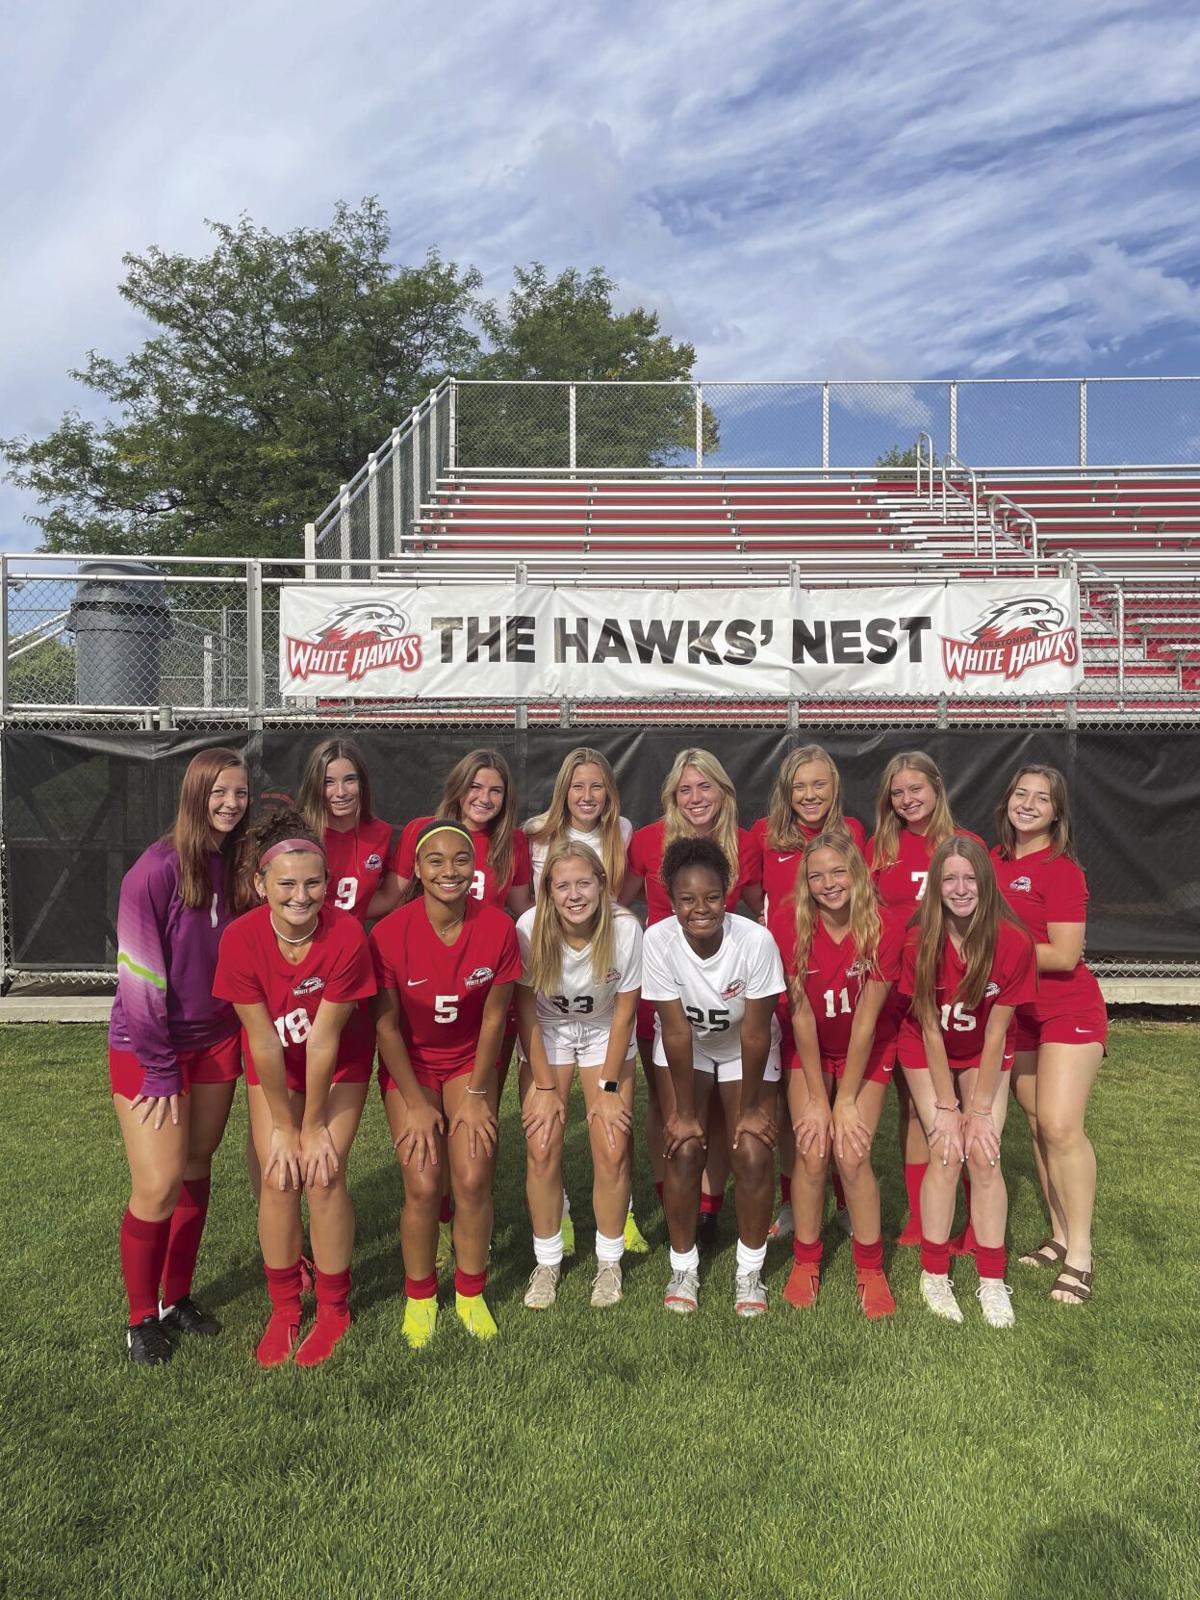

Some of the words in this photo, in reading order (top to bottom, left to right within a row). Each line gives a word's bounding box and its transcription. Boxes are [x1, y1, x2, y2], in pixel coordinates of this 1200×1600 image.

[431, 616, 535, 663] THE
[792, 617, 932, 665] NEST
[945, 640, 1006, 677] WHITE
[1008, 630, 1076, 675] HAWKS
[978, 632, 1036, 648] WESTONKA
[289, 639, 349, 677] WHITE
[350, 637, 419, 677] HAWKS
[335, 876, 359, 910] 9
[911, 871, 929, 901] 7
[434, 995, 459, 1024] 5
[823, 986, 851, 1018] 11
[940, 1002, 976, 1032] 15
[274, 1007, 312, 1048] 18
[686, 1005, 730, 1032] 25
